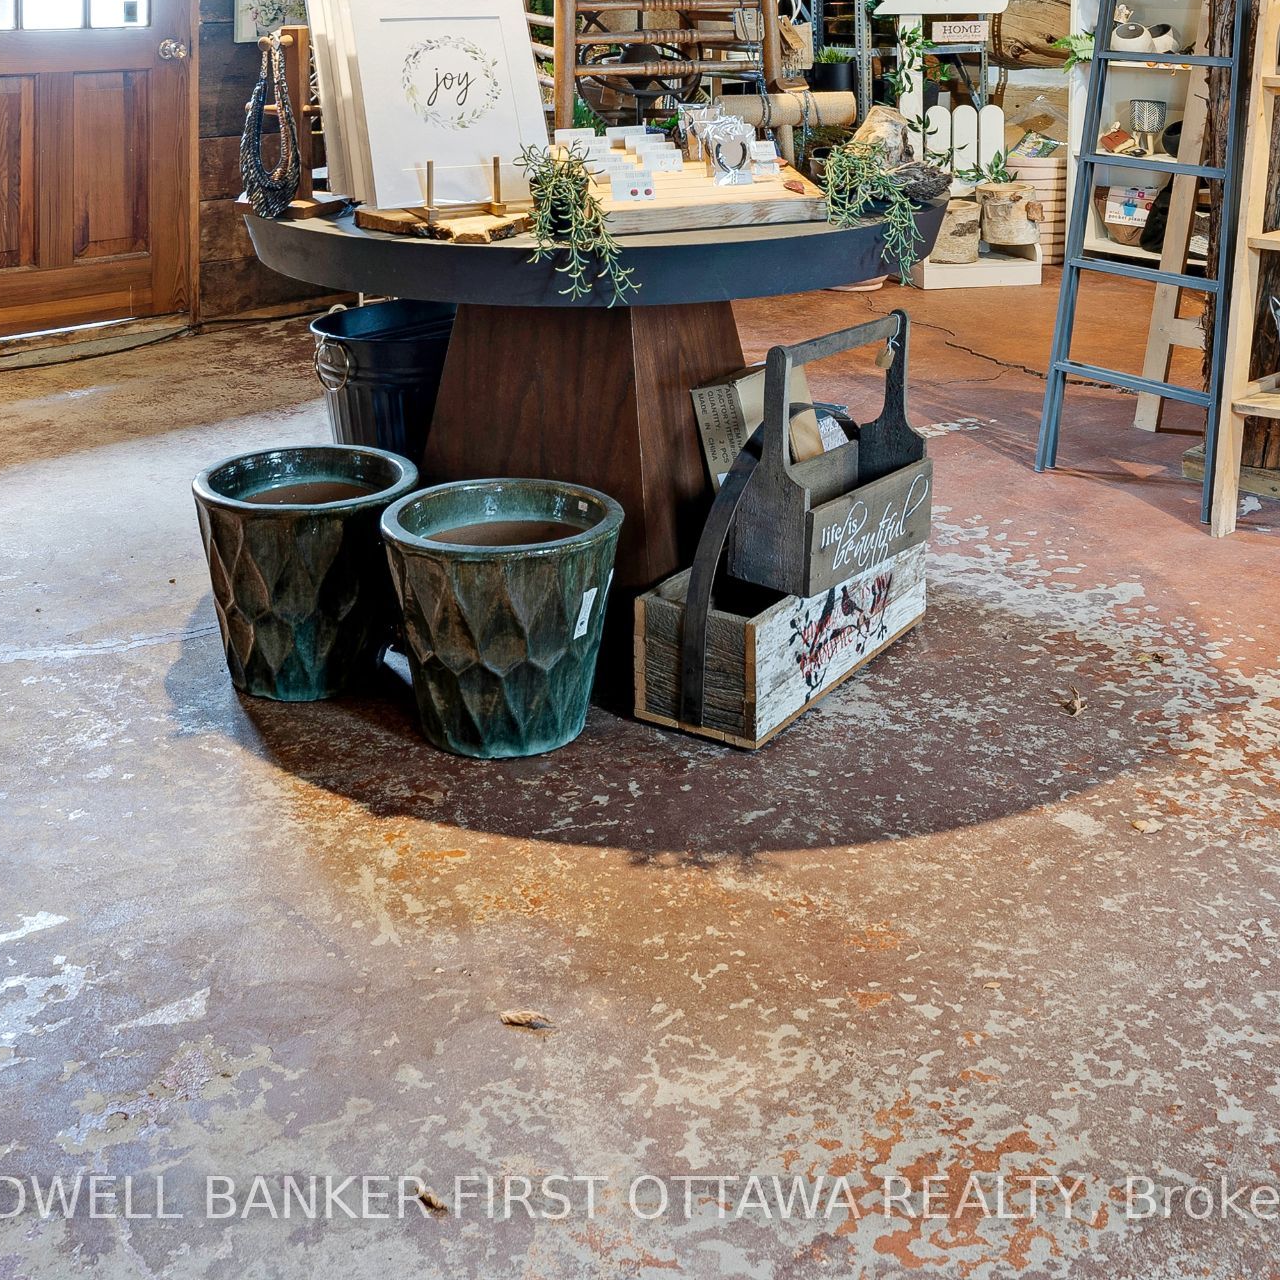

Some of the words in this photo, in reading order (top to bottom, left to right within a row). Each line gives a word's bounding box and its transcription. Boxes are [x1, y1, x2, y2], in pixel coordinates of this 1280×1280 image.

[942, 24, 981, 34] HOME
[426, 65, 478, 107] joy
[697, 393, 708, 416] MADE
[715, 388, 730, 425] FACTORY
[704, 422, 711, 431] IN
[707, 437, 718, 462] CHINA
[720, 447, 730, 464] PCS
[821, 523, 842, 549] life
[848, 516, 858, 535] is
[832, 473, 929, 572] beautiful
